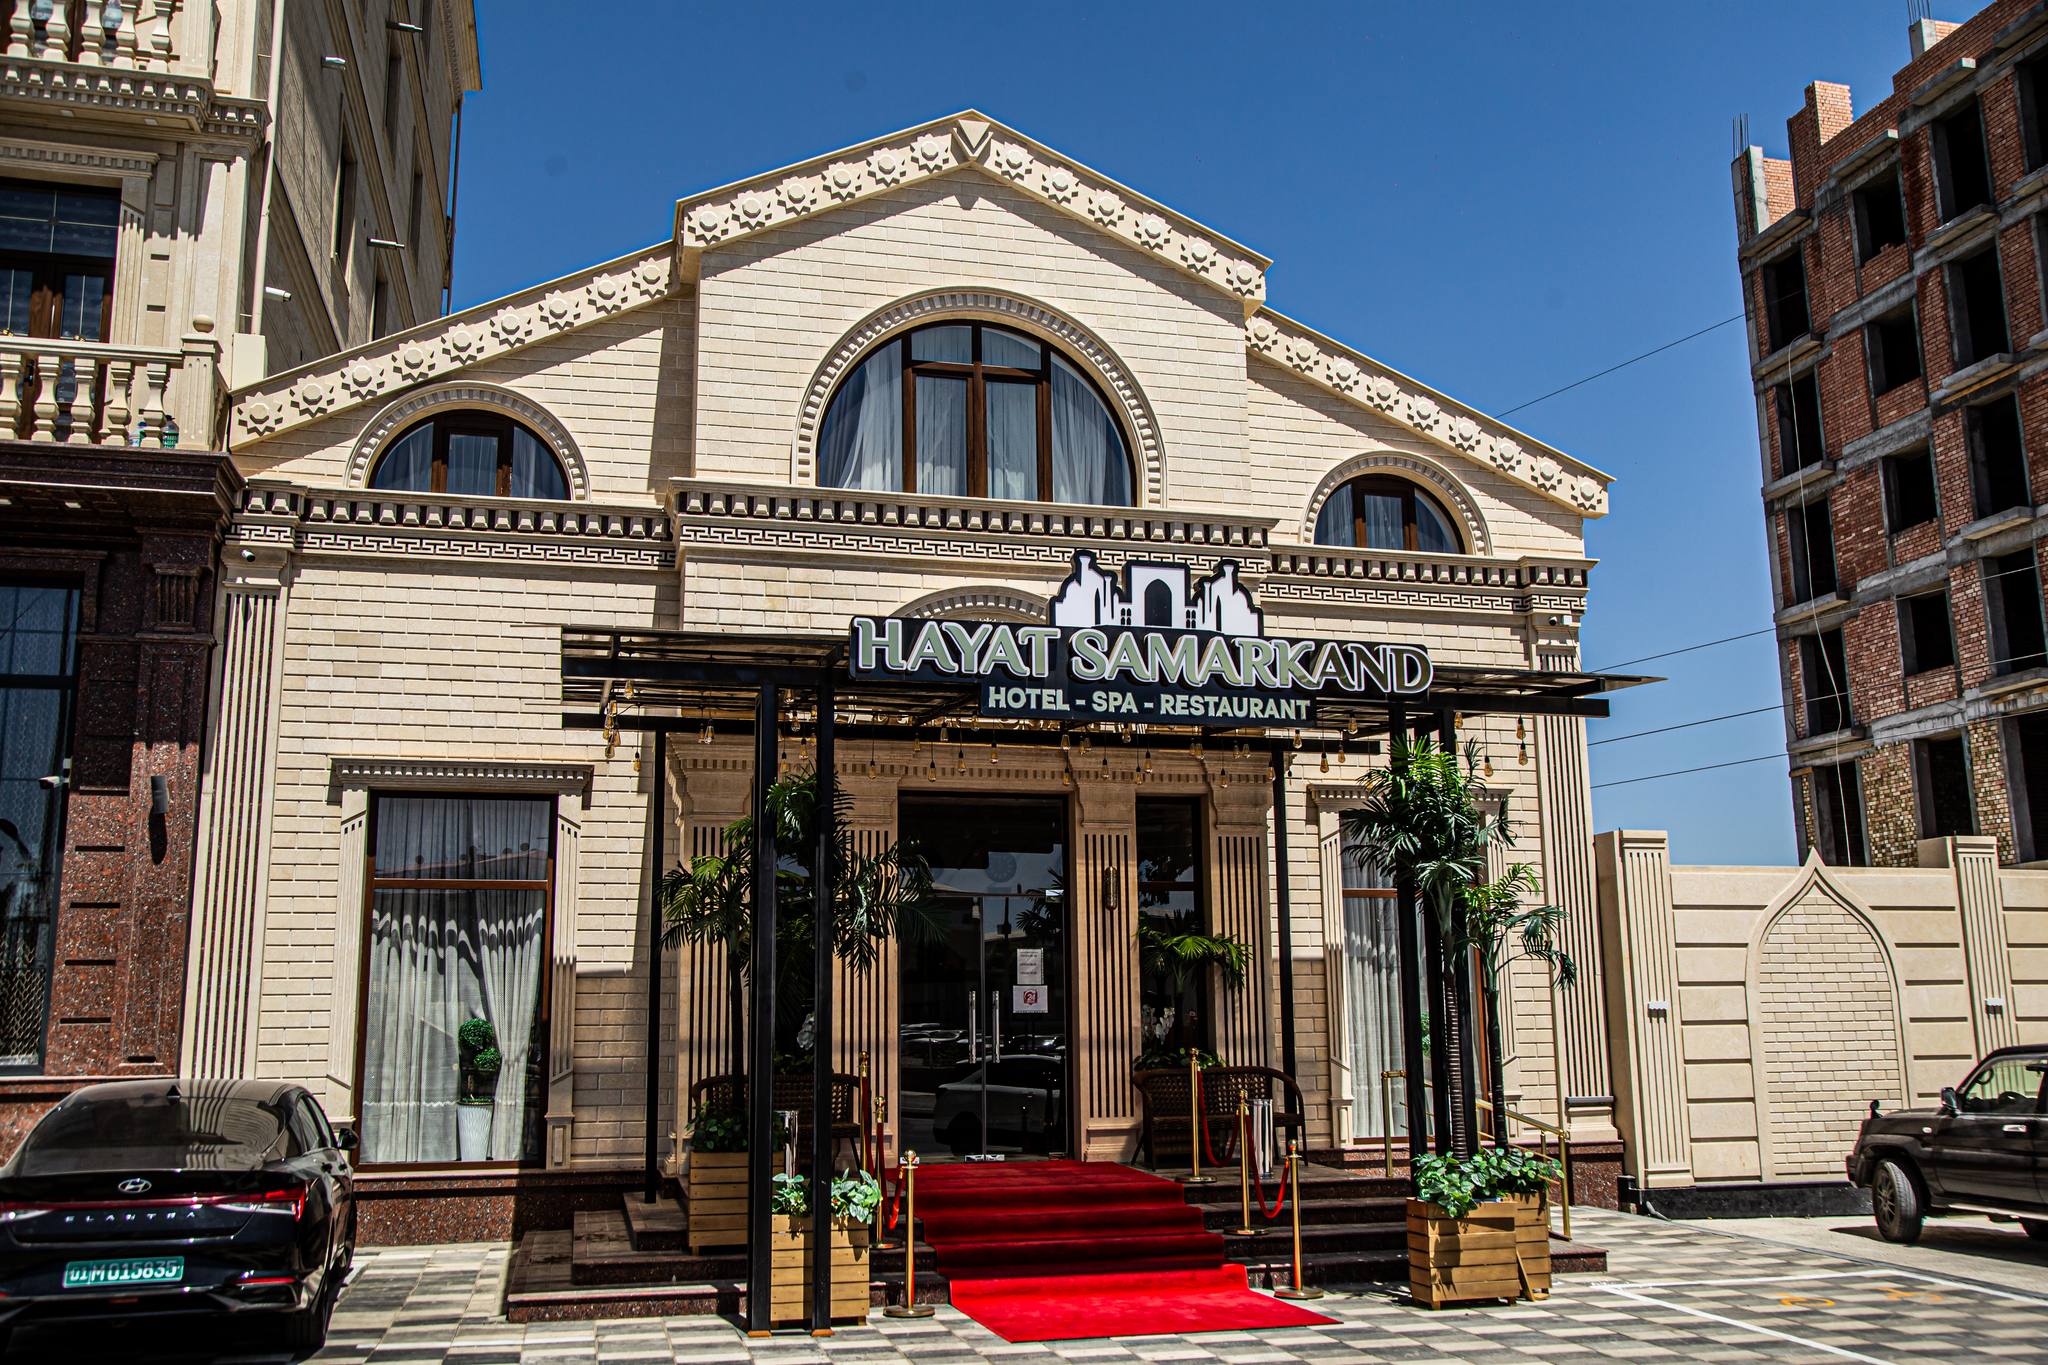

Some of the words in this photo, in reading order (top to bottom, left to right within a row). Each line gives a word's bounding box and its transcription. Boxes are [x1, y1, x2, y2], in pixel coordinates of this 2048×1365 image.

[854, 618, 1061, 678] HAYAT
[1070, 629, 1434, 694] SAMARKAND
[988, 686, 1070, 711] HOTEL
[1092, 690, 1138, 714] SPA
[1160, 694, 1310, 720] RESTAURANT
[65, 1211, 196, 1223] ELANTRA
